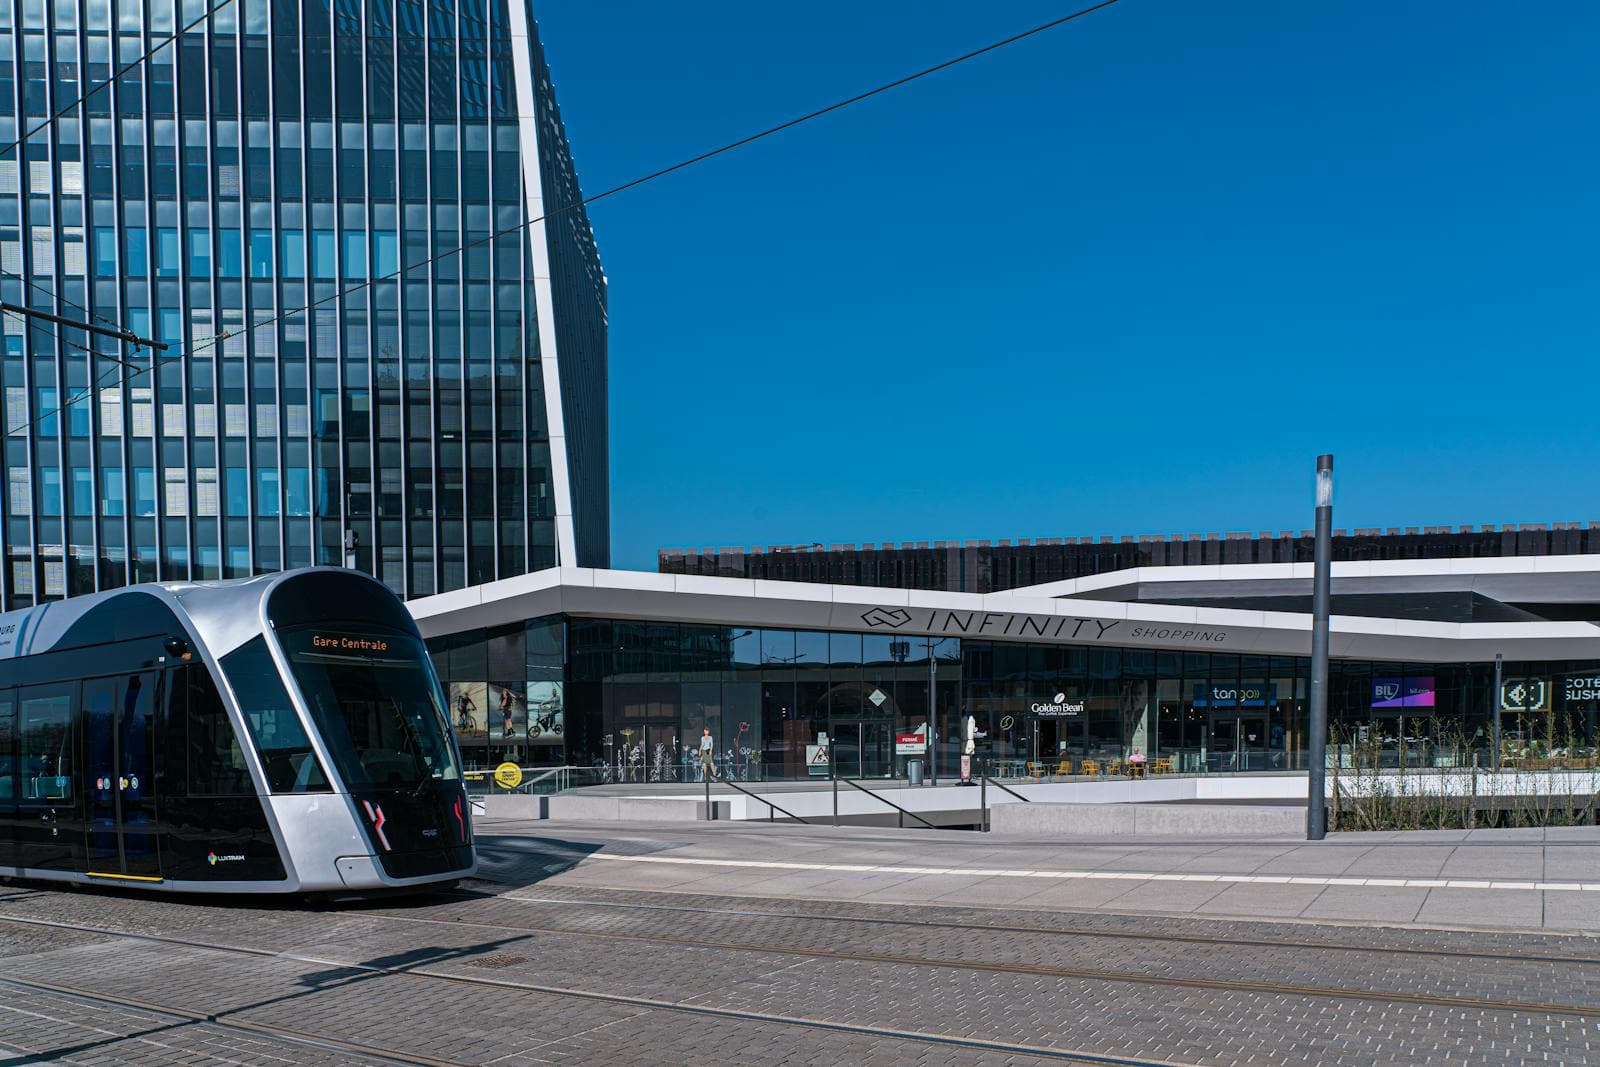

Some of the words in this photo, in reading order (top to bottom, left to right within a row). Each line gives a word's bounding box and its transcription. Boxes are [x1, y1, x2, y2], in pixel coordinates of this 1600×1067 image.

[926, 610, 1120, 640] INFINITY
[1131, 627, 1226, 642] SHOPPING
[313, 635, 338, 647] Gare
[341, 637, 387, 651] Centrale
[1375, 685, 1394, 696] BIL
[1031, 703, 1062, 713] Golden
[1062, 702, 1084, 712] Bean
